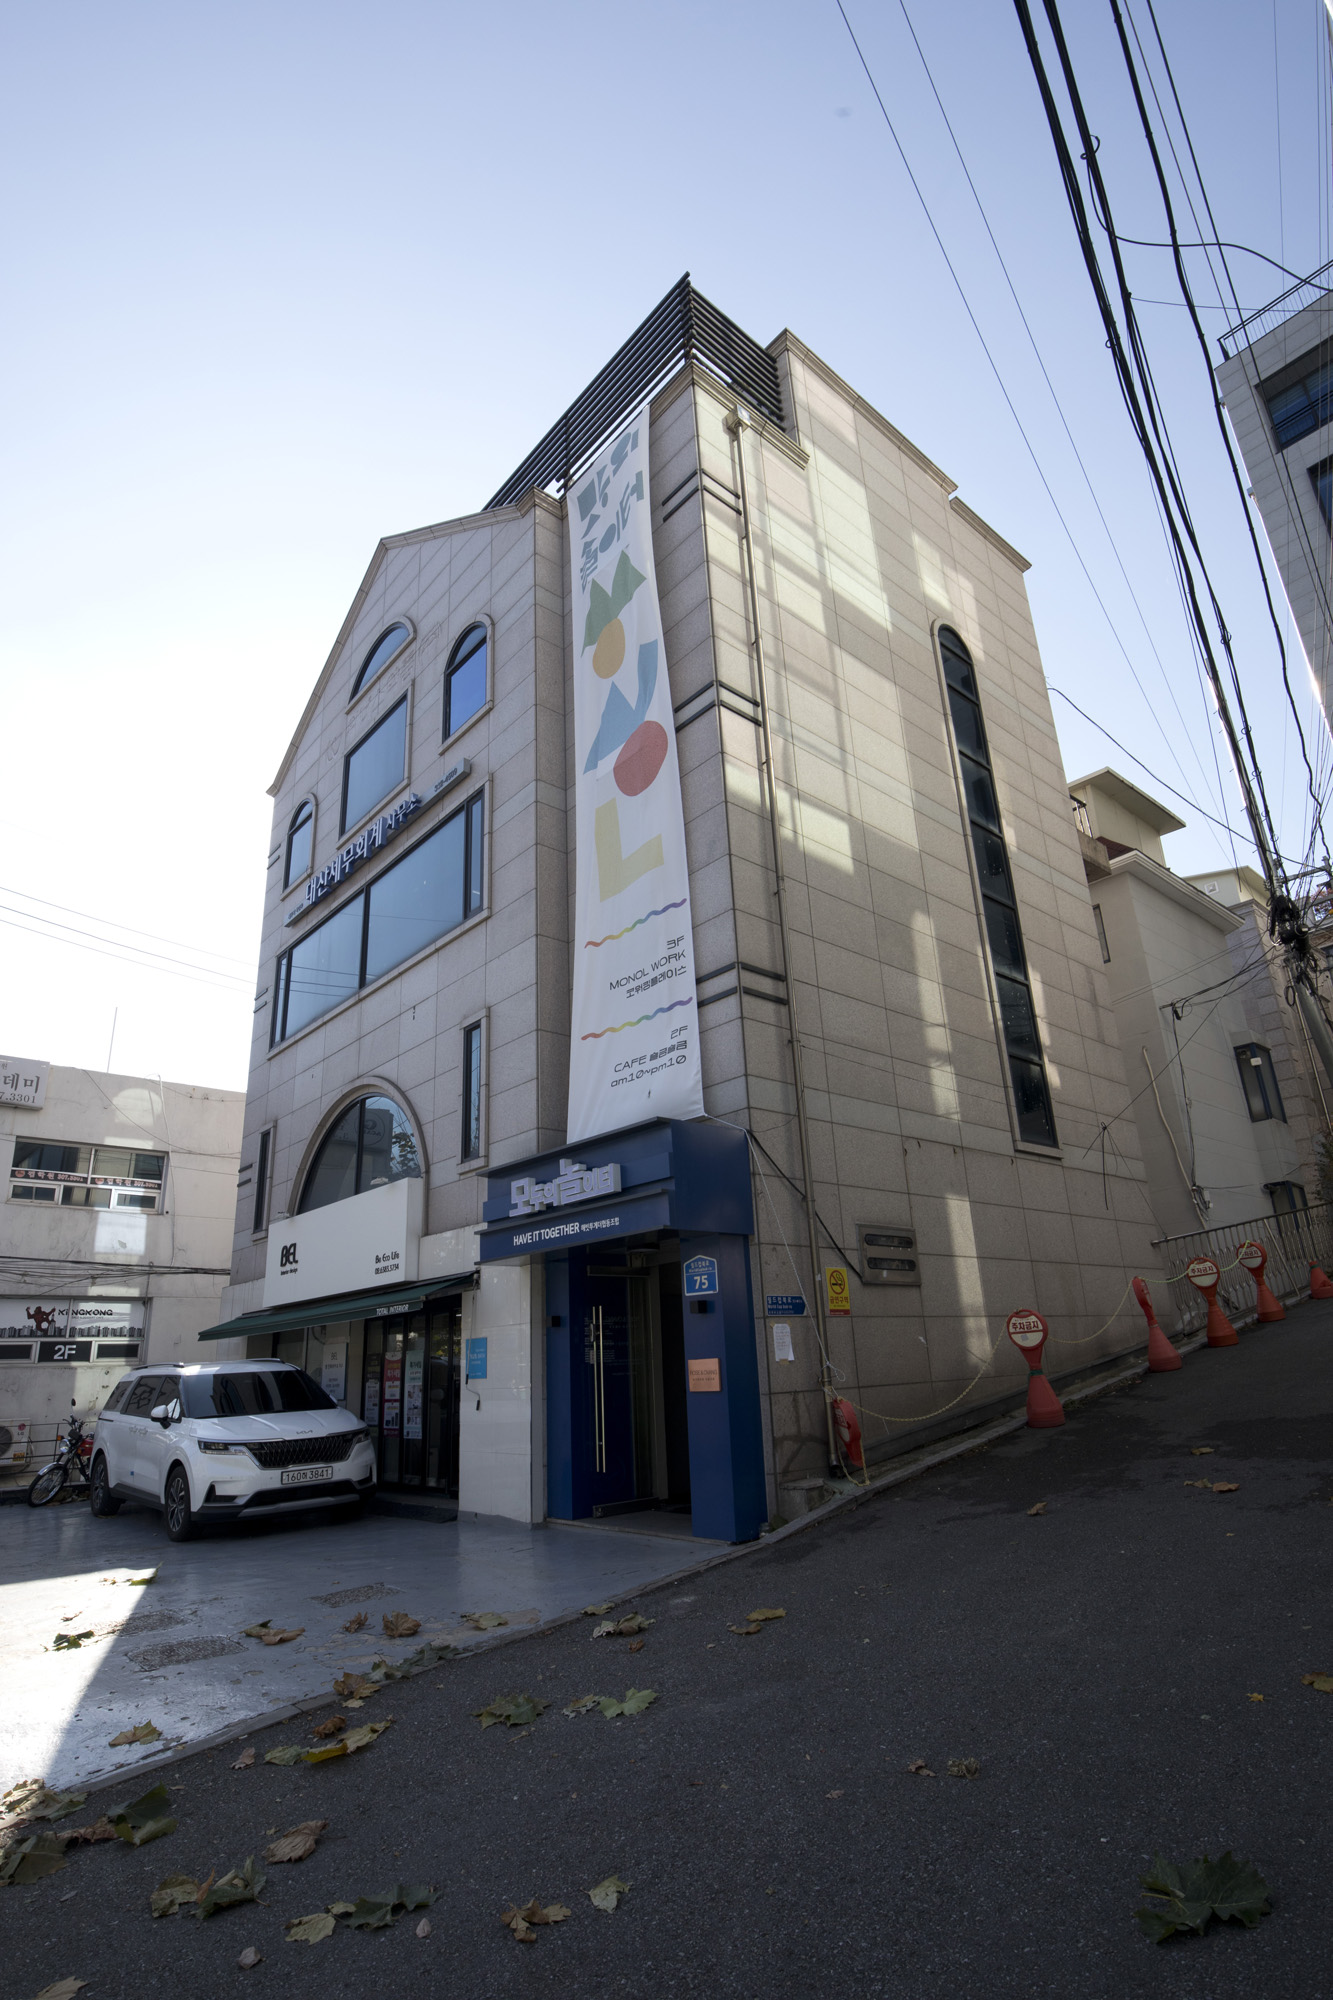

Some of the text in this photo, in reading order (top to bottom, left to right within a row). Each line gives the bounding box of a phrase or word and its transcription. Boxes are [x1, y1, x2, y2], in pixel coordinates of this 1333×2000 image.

[666, 935, 685, 950] 3F
[609, 949, 687, 991] MONOL WORK
[626, 965, 687, 999] 코워킹플레이스
[670, 1025, 688, 1039] 2F
[614, 1054, 648, 1073] CAFE
[513, 1233, 533, 1246] HAVE
[533, 1231, 540, 1242] IT
[540, 1222, 580, 1240] TOGETHER
[375, 1254, 381, 1264] Be
[693, 1275, 709, 1290] 75
[376, 1304, 409, 1316] TOTAL INTERIOR
[1011, 1320, 1040, 1331] 주차금지
[53, 1345, 77, 1360] 2F
